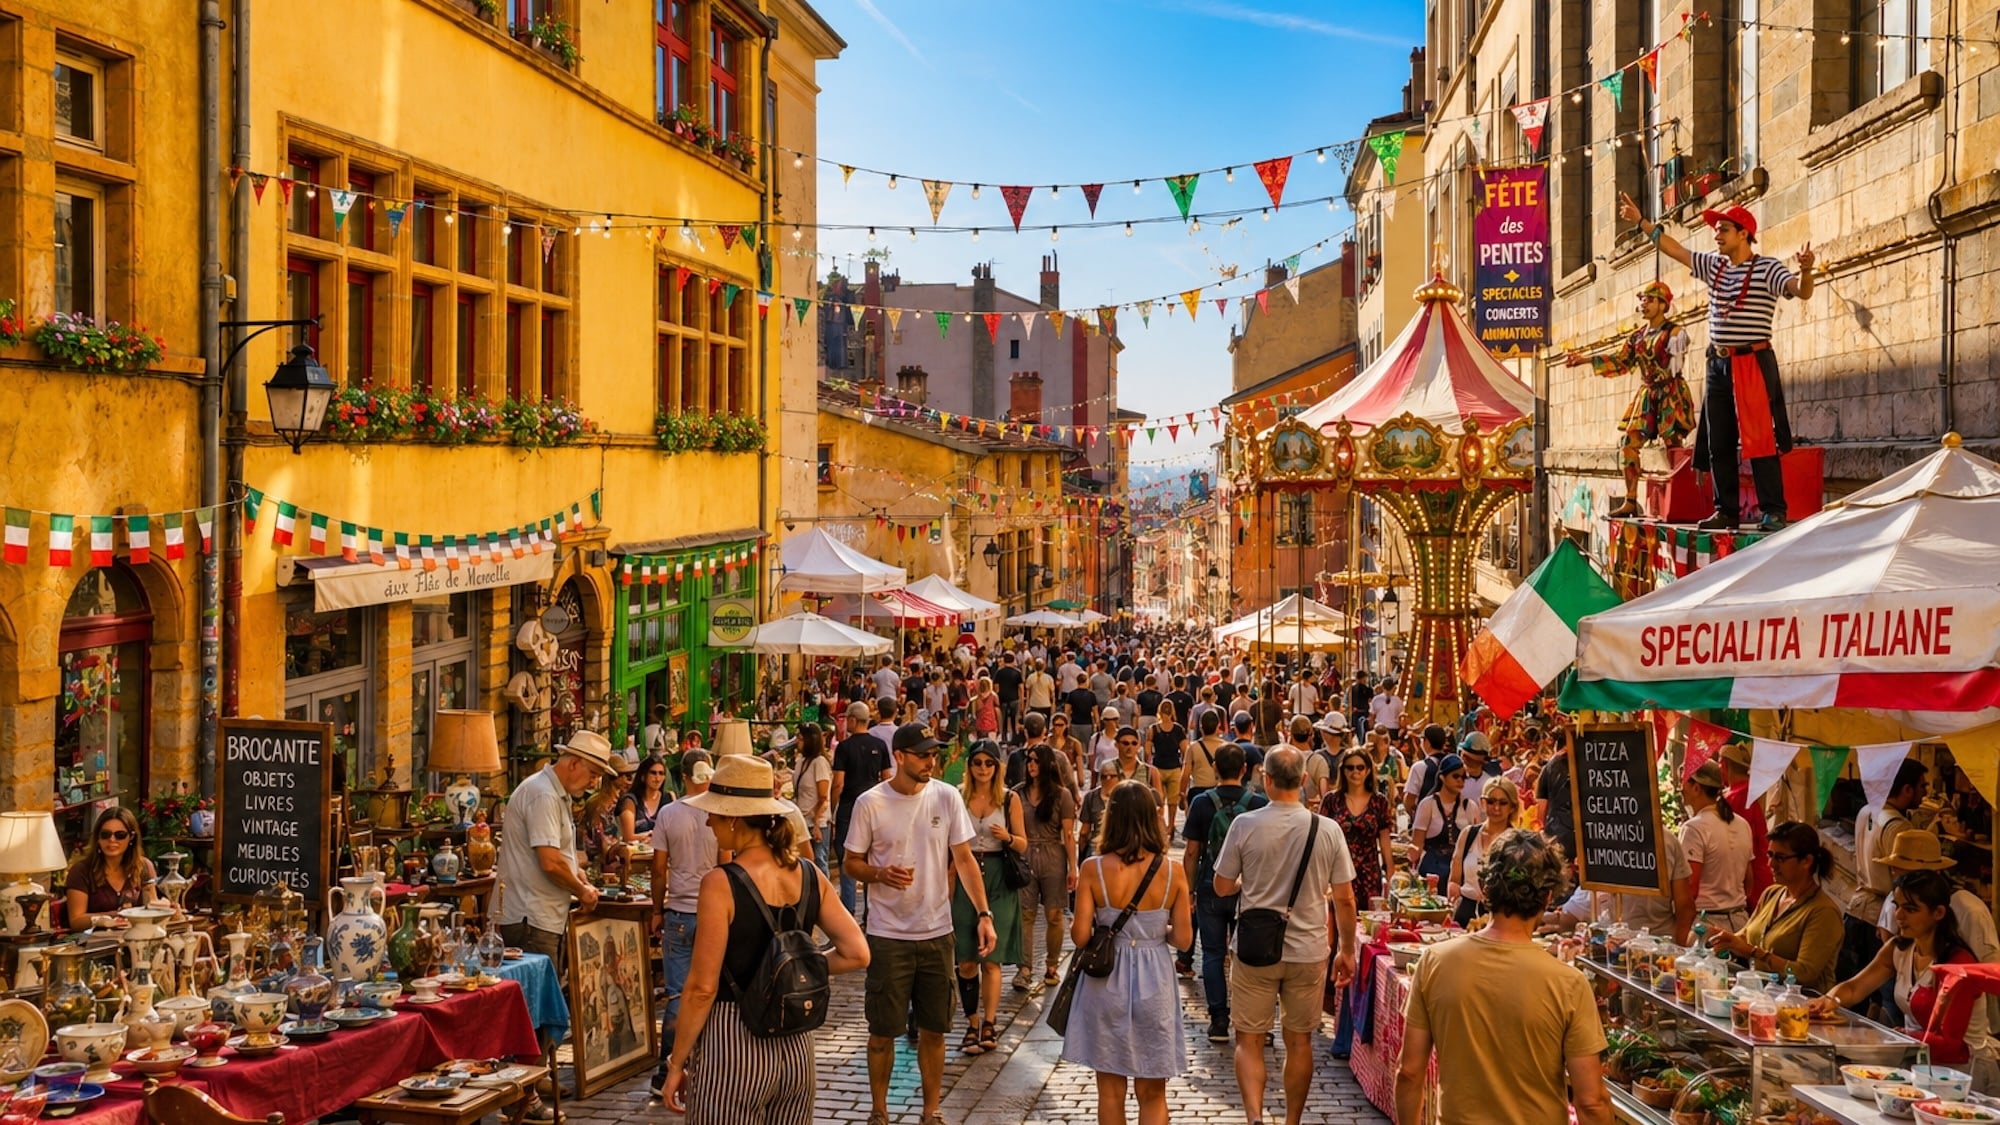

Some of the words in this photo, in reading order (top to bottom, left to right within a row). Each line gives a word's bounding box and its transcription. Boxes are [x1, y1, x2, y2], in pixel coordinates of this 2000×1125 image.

[1484, 175, 1538, 208] FÊTE
[1499, 215, 1524, 234] des
[1480, 241, 1543, 266] PENTES
[1482, 287, 1542, 301] SPECTACLES
[1485, 306, 1539, 321] CONCERTS
[1482, 326, 1544, 341] ANIMATIONS
[445, 568, 459, 589] de
[1640, 617, 1801, 667] SPECIALITA
[1819, 606, 1953, 659] ITALIANE
[227, 735, 320, 765] BROCANTE
[1584, 741, 1629, 762] PIZZA
[242, 770, 296, 789] OBJETS
[1588, 769, 1630, 788] PASTA
[245, 794, 294, 812] LIVRES
[1586, 796, 1638, 815] GELATO
[241, 819, 299, 837] VINTAGE
[237, 843, 300, 862] MEUBLES
[1586, 847, 1656, 870] LIMONCELLO
